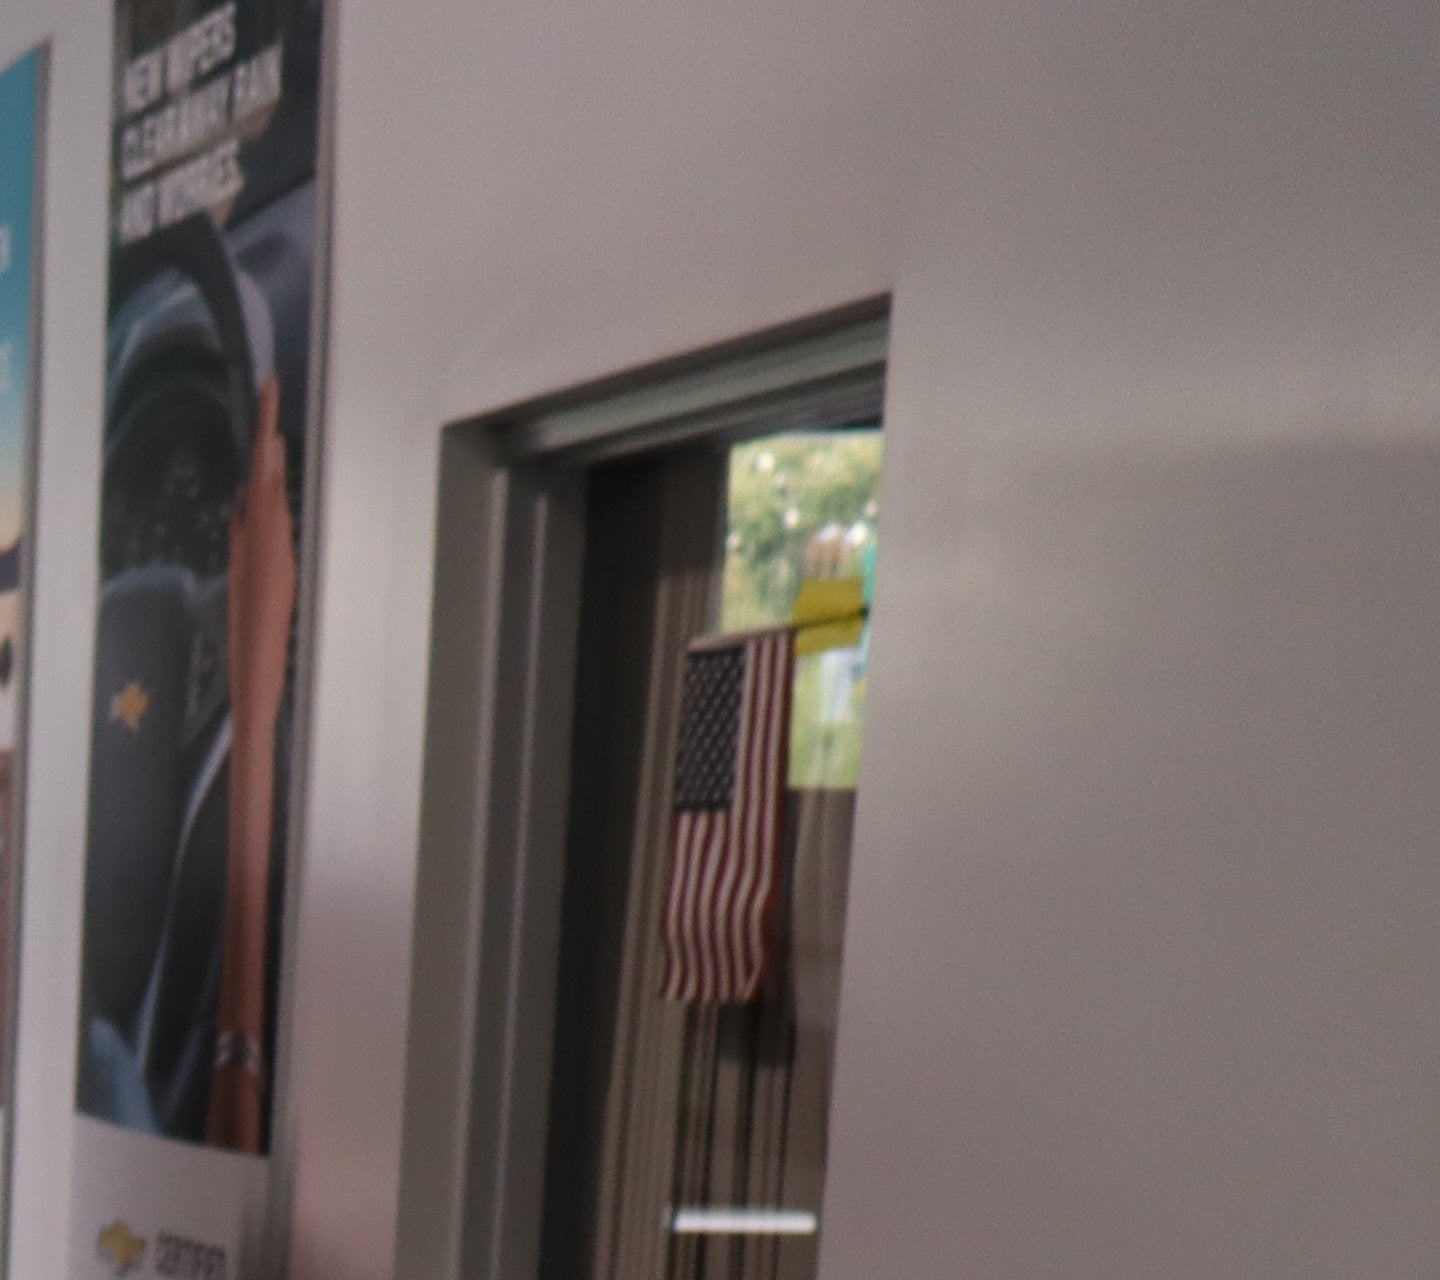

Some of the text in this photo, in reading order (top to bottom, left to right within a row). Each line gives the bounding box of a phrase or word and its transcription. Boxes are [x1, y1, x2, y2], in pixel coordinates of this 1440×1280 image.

[122, 2, 236, 113] NEW WIPERS
[232, 44, 283, 120] RAIN
